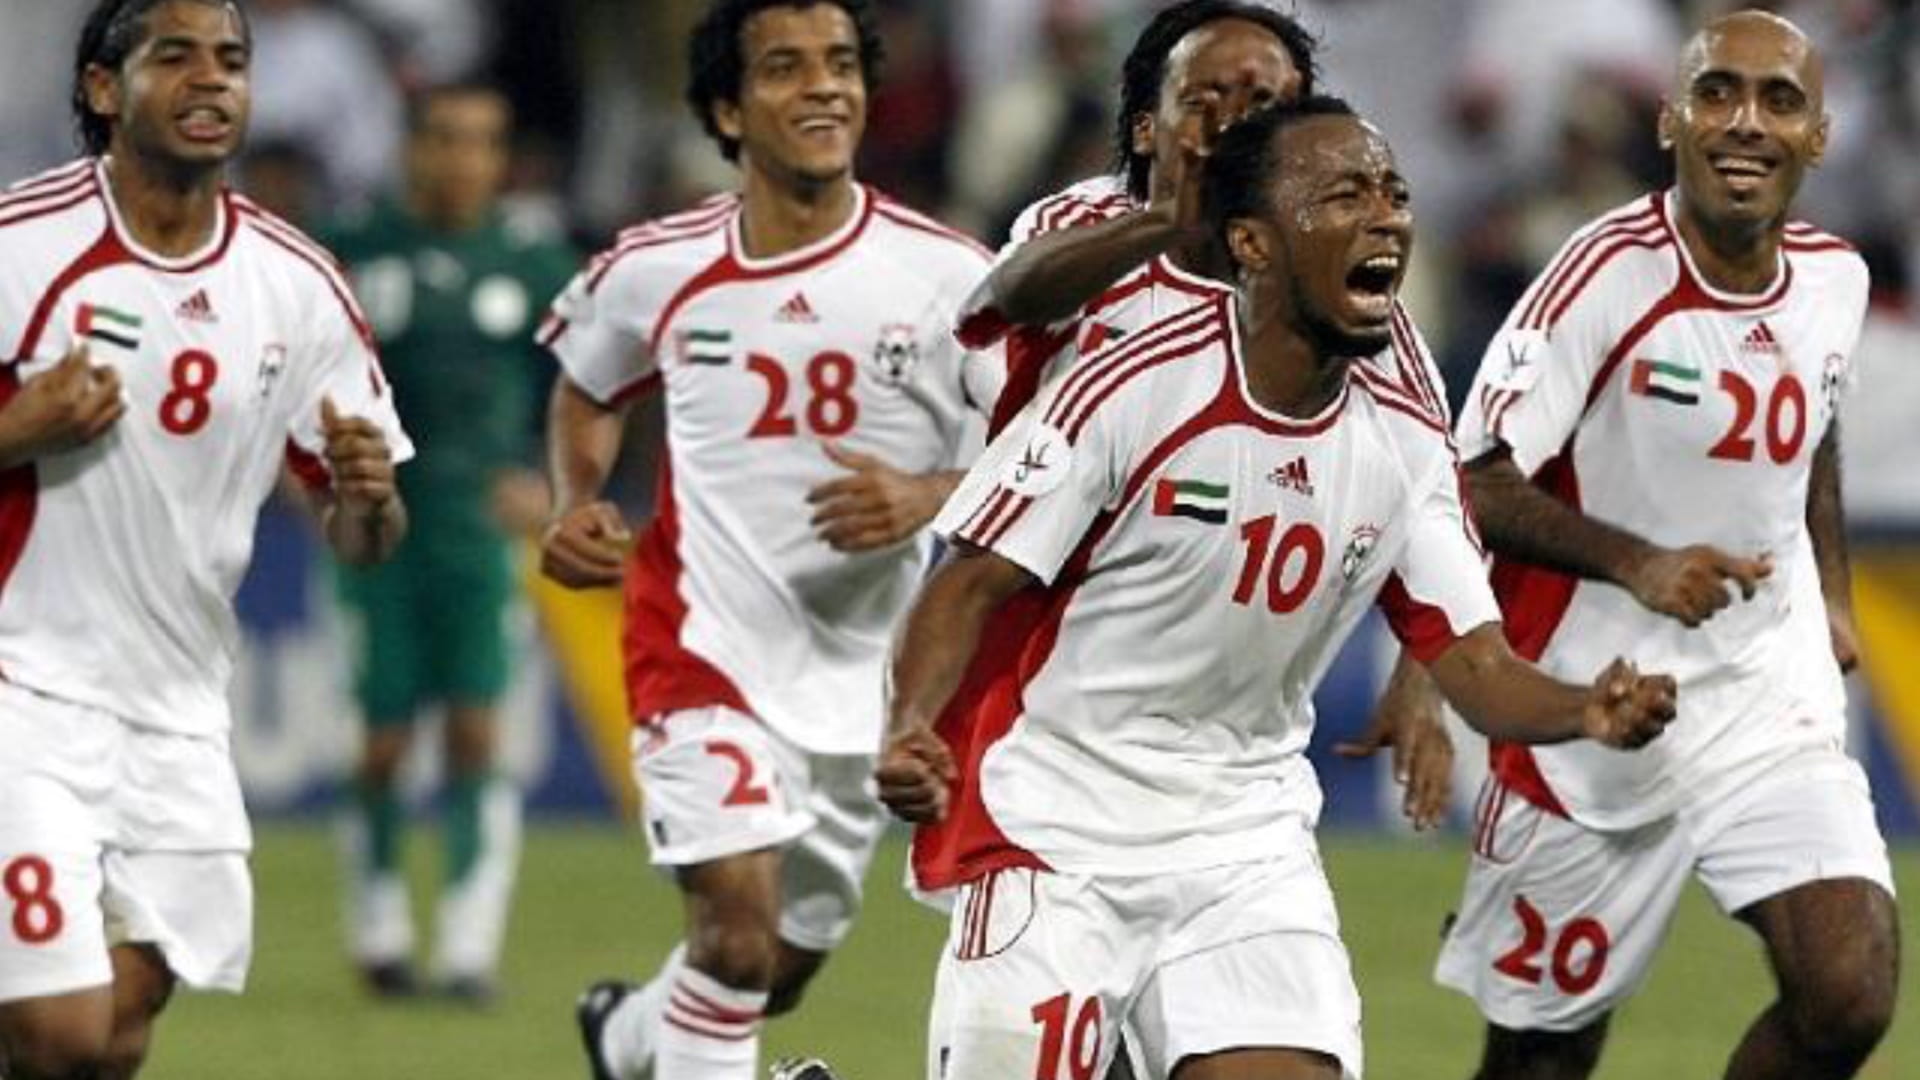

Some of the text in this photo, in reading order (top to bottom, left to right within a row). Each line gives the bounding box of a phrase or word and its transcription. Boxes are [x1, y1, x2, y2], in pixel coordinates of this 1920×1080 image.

[159, 348, 220, 435] 8
[747, 352, 856, 440] 28
[1709, 370, 1807, 464] 20
[1234, 515, 1323, 613] 10
[706, 740, 769, 806] 2
[4, 854, 64, 945] 8
[1493, 894, 1609, 994] 20
[1032, 993, 1101, 1080] 10
